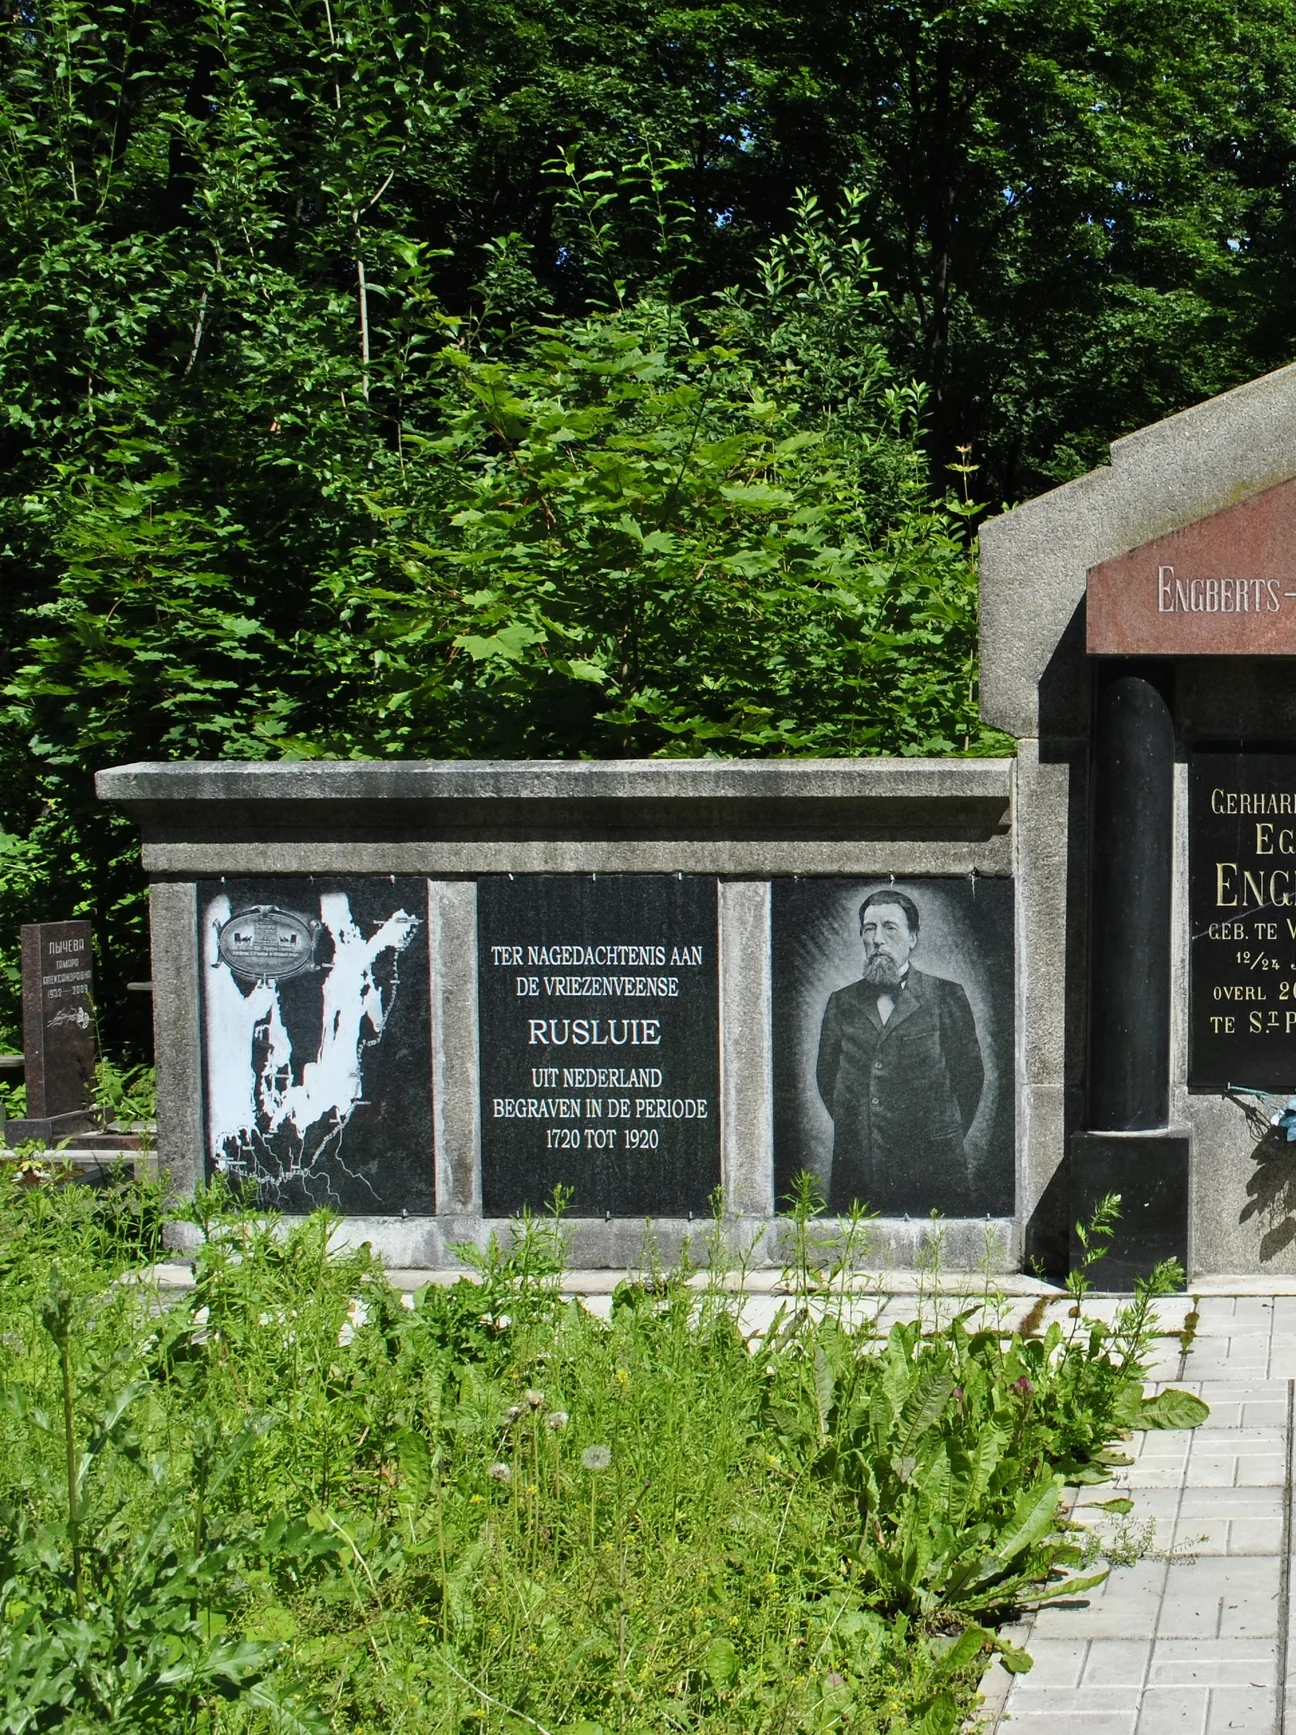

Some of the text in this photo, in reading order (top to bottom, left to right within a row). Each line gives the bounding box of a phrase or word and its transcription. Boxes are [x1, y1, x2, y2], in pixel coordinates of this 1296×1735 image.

[1254, 922, 1278, 940] TE
[49, 939, 84, 954] ЛЫЧЕВА
[491, 945, 703, 966] TER NAGEDACHTENIS AAN
[516, 976, 679, 997] DE VRIEZENVEENSE
[1213, 985, 1267, 1001] OVERL
[528, 1019, 662, 1045] RUSLUIE
[1210, 1016, 1235, 1034] TE
[531, 1067, 663, 1088] UIT NEDERLAND
[493, 1098, 708, 1119] BEGRAVEN IN DE PERIODE
[546, 1128, 660, 1149] 1720 TOT 1920
